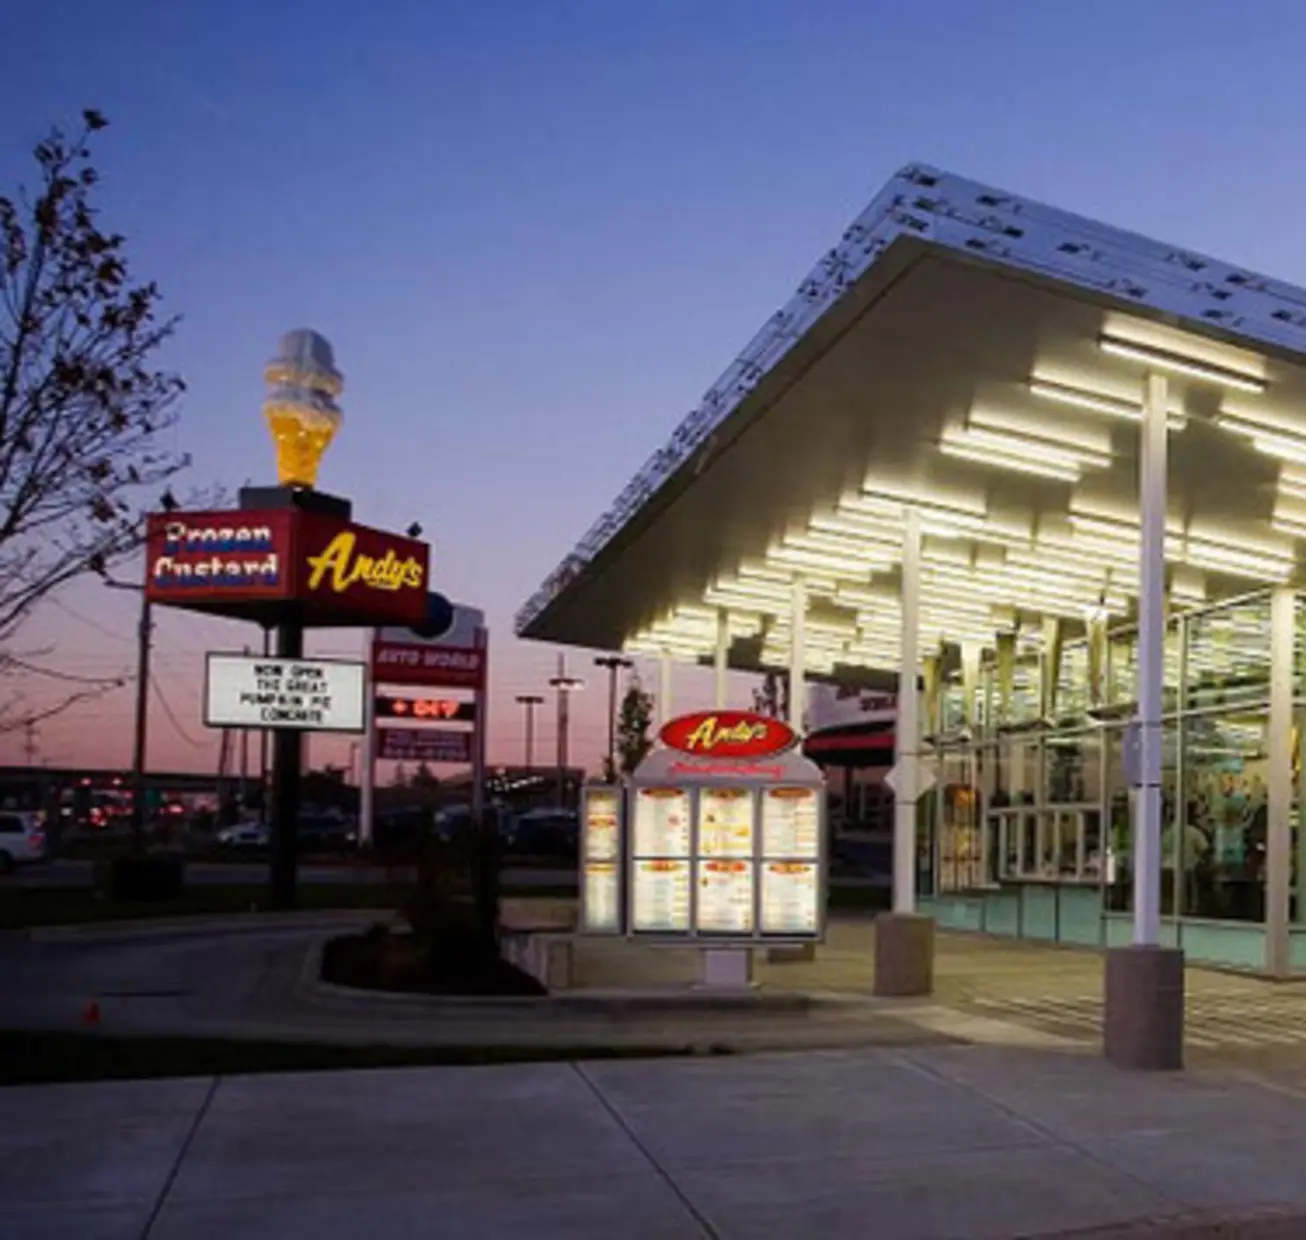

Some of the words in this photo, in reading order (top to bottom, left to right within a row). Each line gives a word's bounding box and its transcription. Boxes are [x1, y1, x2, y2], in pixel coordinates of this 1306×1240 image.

[153, 552, 279, 588] Custard
[306, 531, 423, 593] Andy's
[377, 648, 420, 666] AUTO
[424, 650, 481, 670] WORLD
[254, 664, 282, 677] NOW
[290, 665, 323, 679] OPEN
[256, 678, 281, 691] THE
[285, 680, 328, 694] GREAT
[239, 692, 303, 706] PUMPKIN
[310, 695, 332, 709] PIE
[260, 707, 323, 723] CONCRETE
[685, 716, 768, 750] Andy's
